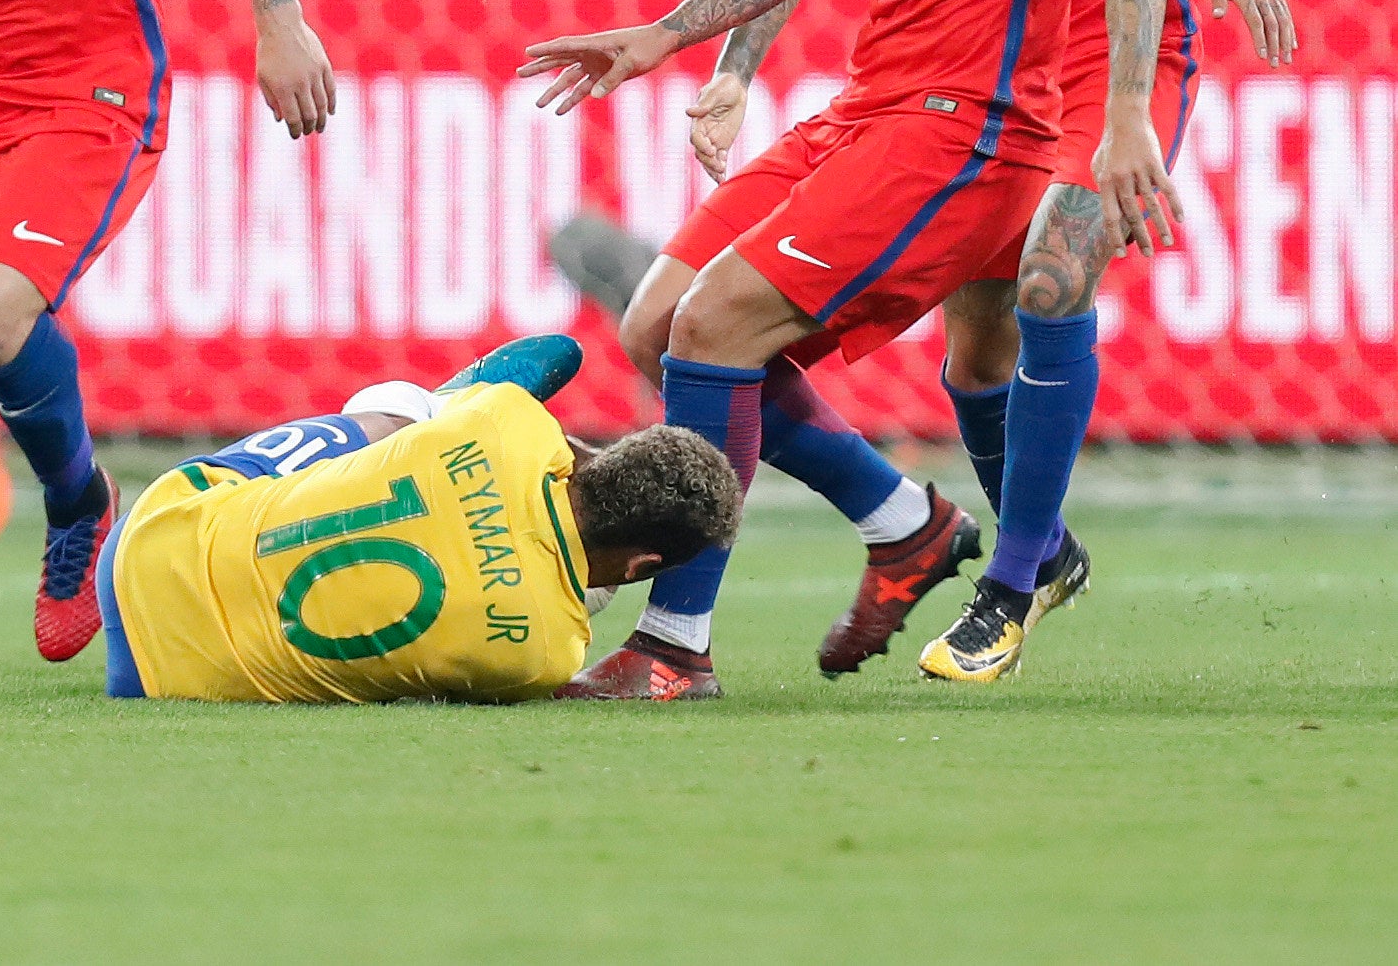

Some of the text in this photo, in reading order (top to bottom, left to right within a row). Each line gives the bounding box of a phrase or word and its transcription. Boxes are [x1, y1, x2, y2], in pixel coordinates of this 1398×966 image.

[256, 474, 446, 662] 10
[439, 439, 530, 645] NEYMAR JR
